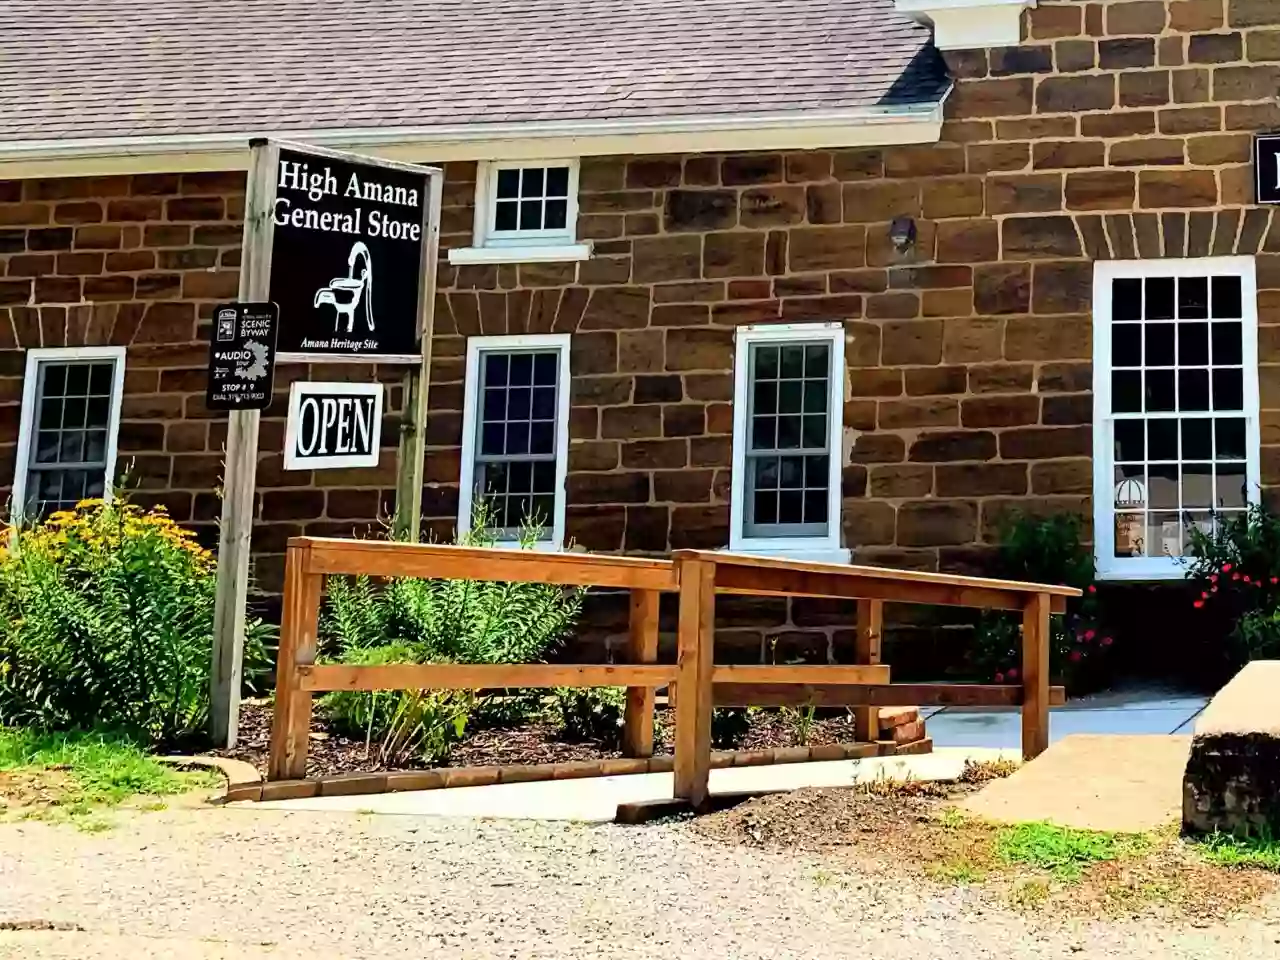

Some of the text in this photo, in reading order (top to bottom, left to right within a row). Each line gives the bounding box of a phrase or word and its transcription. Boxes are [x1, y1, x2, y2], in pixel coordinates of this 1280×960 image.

[278, 160, 418, 207] High Amana
[273, 197, 421, 241] General Store
[241, 320, 271, 328] SCENIC
[220, 351, 251, 360] AUDIO
[300, 337, 378, 352] Amana Heritage Site
[297, 397, 374, 456] OPEN
